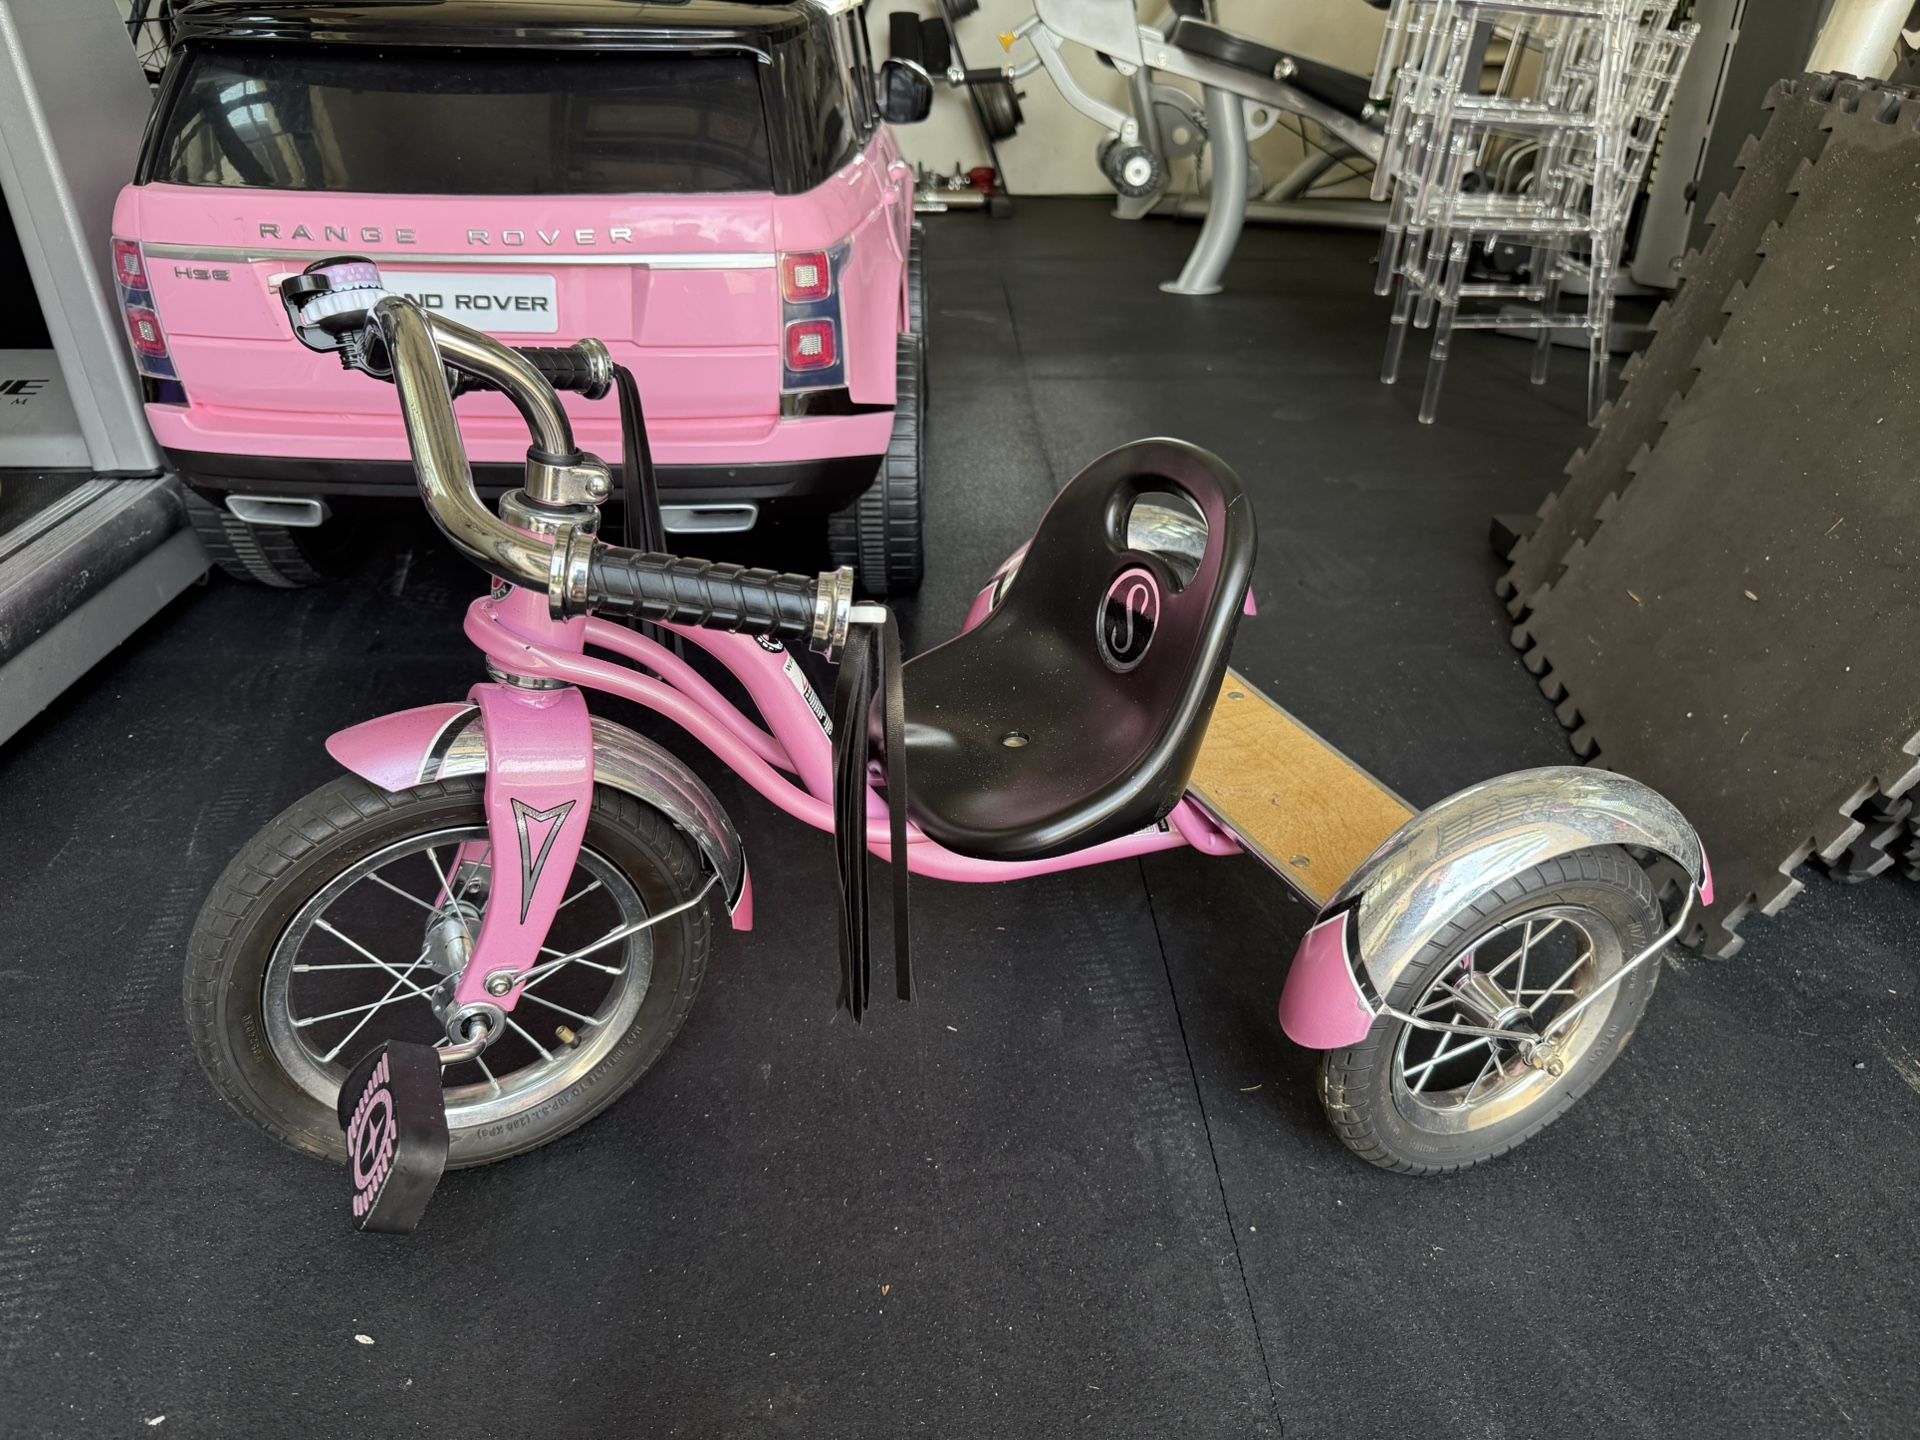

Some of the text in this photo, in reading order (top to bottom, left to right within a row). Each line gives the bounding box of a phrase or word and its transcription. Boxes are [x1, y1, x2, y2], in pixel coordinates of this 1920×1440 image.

[259, 223, 633, 246] RANGE ROVER
[174, 266, 231, 281] HSE
[404, 293, 549, 312] ND ROVER
